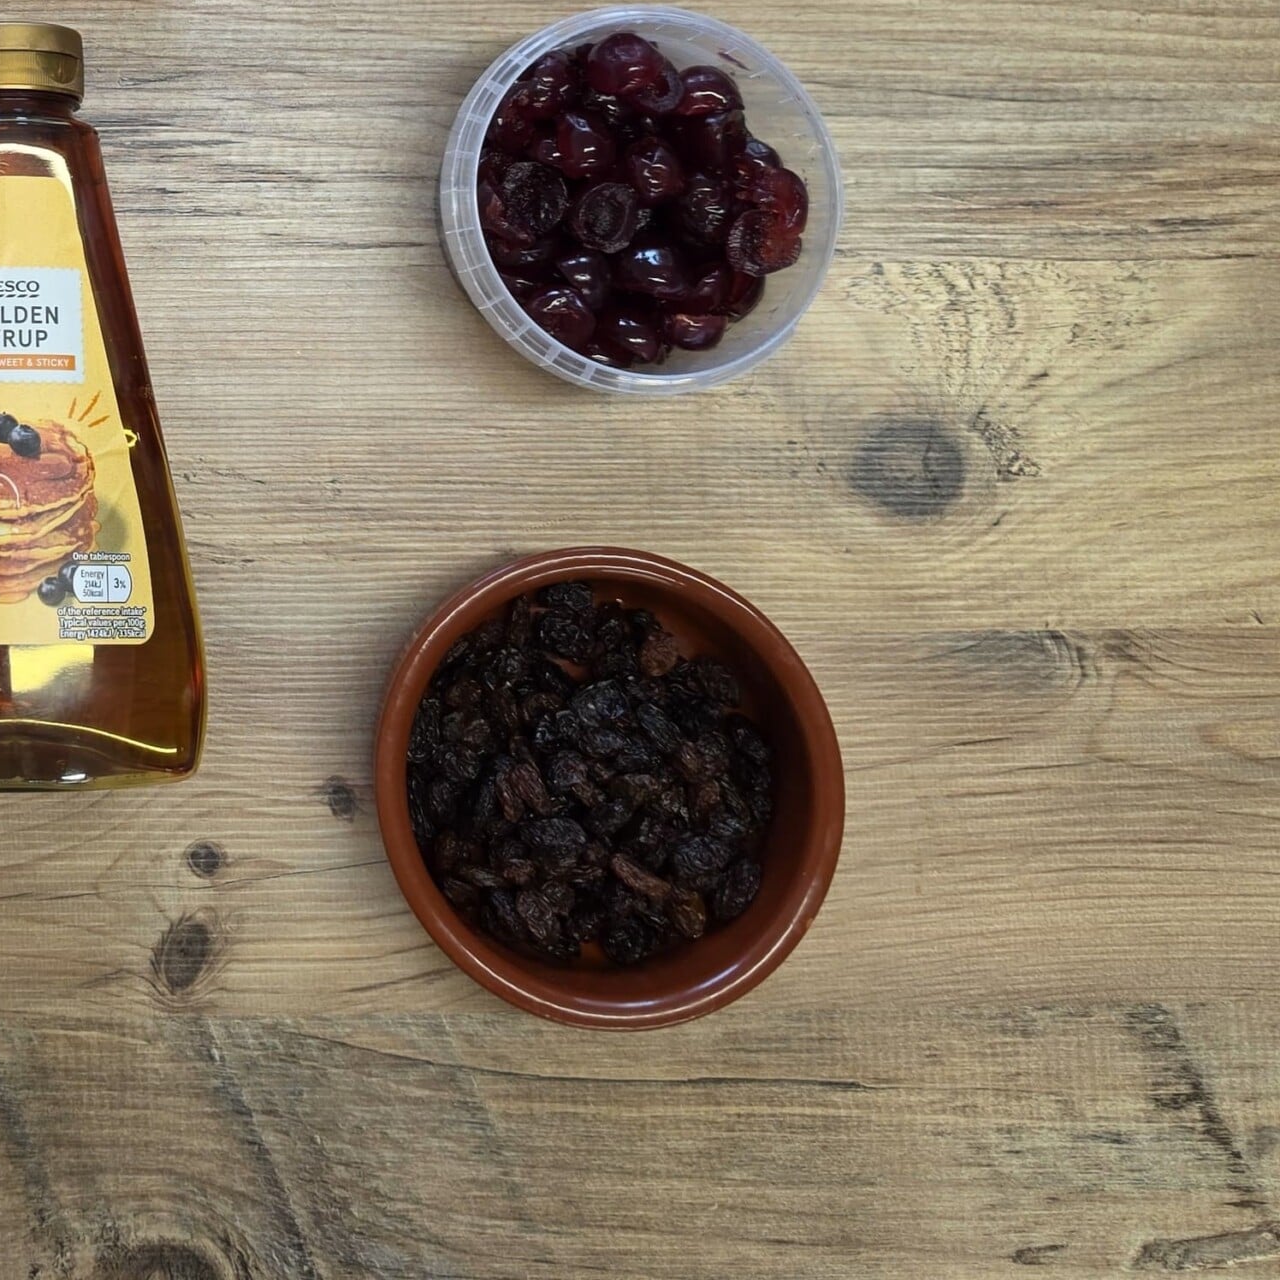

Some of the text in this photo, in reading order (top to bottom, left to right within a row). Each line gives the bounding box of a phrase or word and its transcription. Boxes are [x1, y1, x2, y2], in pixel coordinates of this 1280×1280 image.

[26, 358, 33, 367] &
[35, 357, 70, 368] STICKY
[72, 552, 131, 563] One tablespoon
[80, 570, 105, 579] Energy
[113, 577, 126, 589] 3%
[57, 607, 67, 616] of
[67, 607, 81, 616] the
[82, 607, 120, 616] reference
[60, 618, 127, 629] Typical values per
[60, 629, 85, 639] Energy
